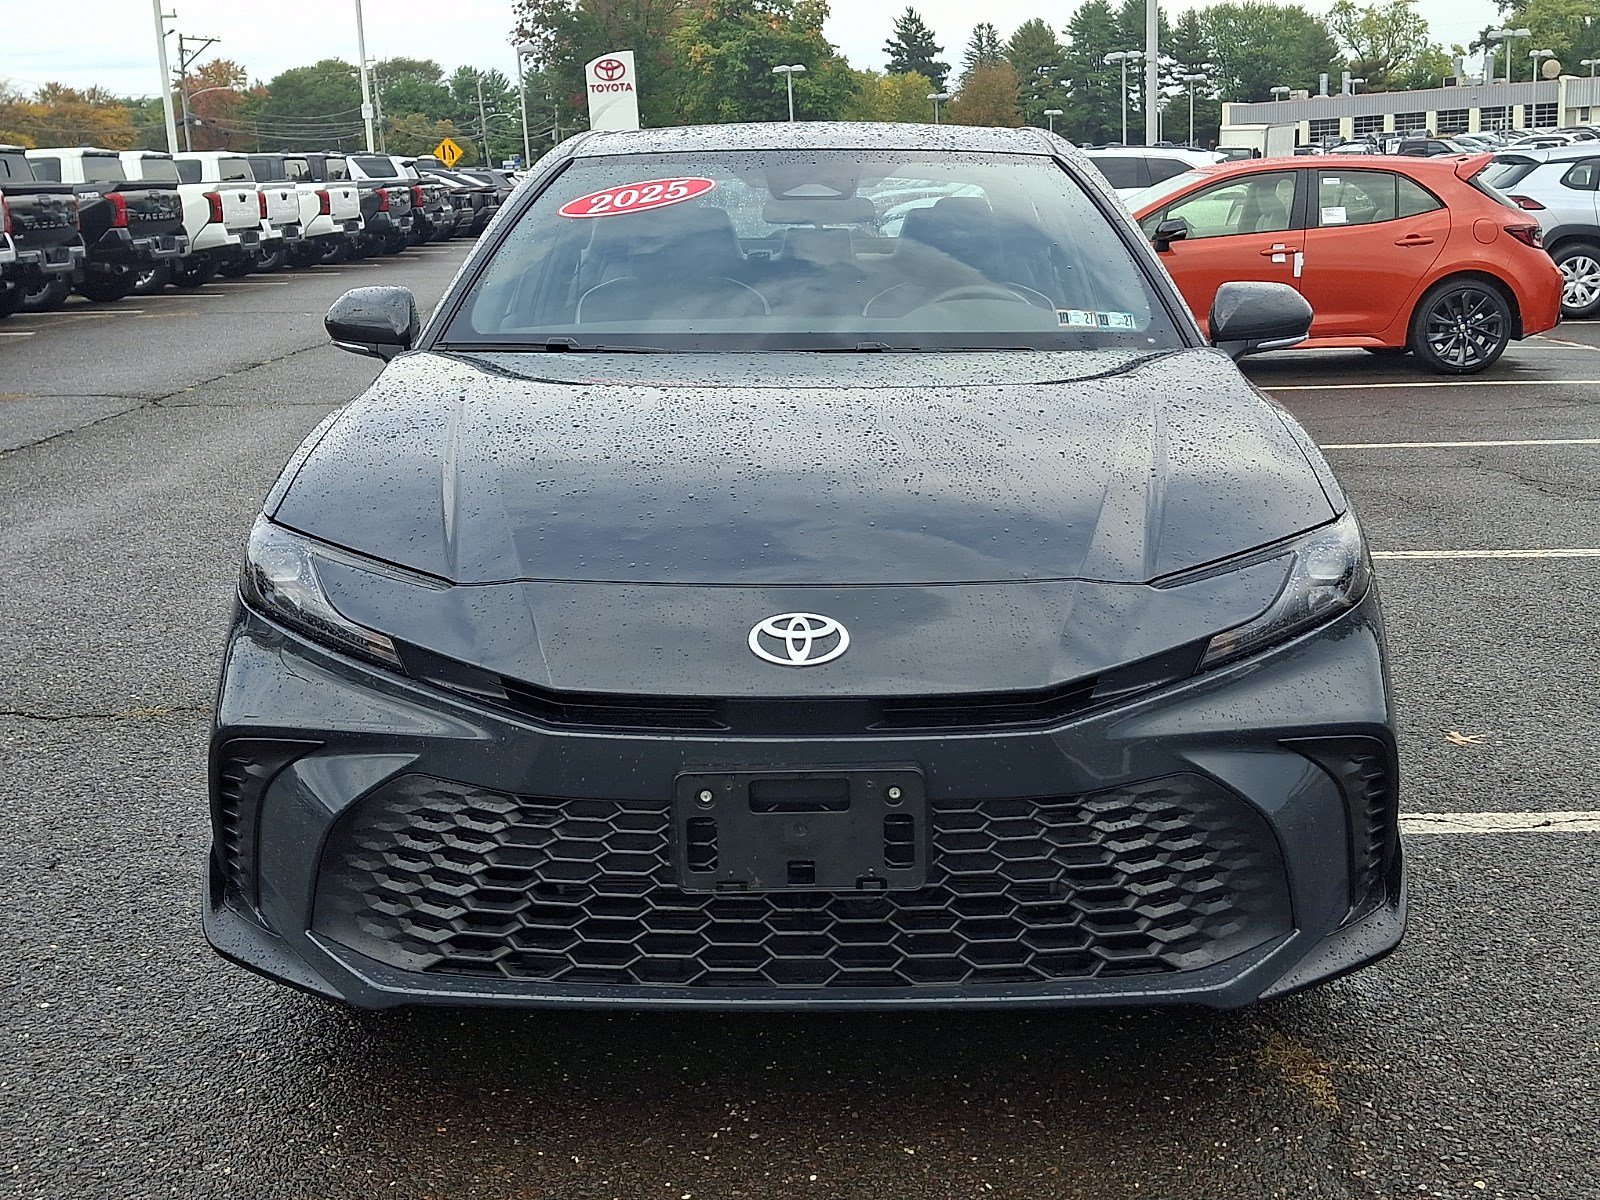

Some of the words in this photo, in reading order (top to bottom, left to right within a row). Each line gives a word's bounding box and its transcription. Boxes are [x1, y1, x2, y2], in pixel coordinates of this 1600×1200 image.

[589, 82, 633, 93] TOYOTA
[586, 180, 690, 214] 2025
[138, 212, 176, 221] TACOMA
[1084, 313, 1093, 324] 27
[1124, 315, 1133, 327] 27
